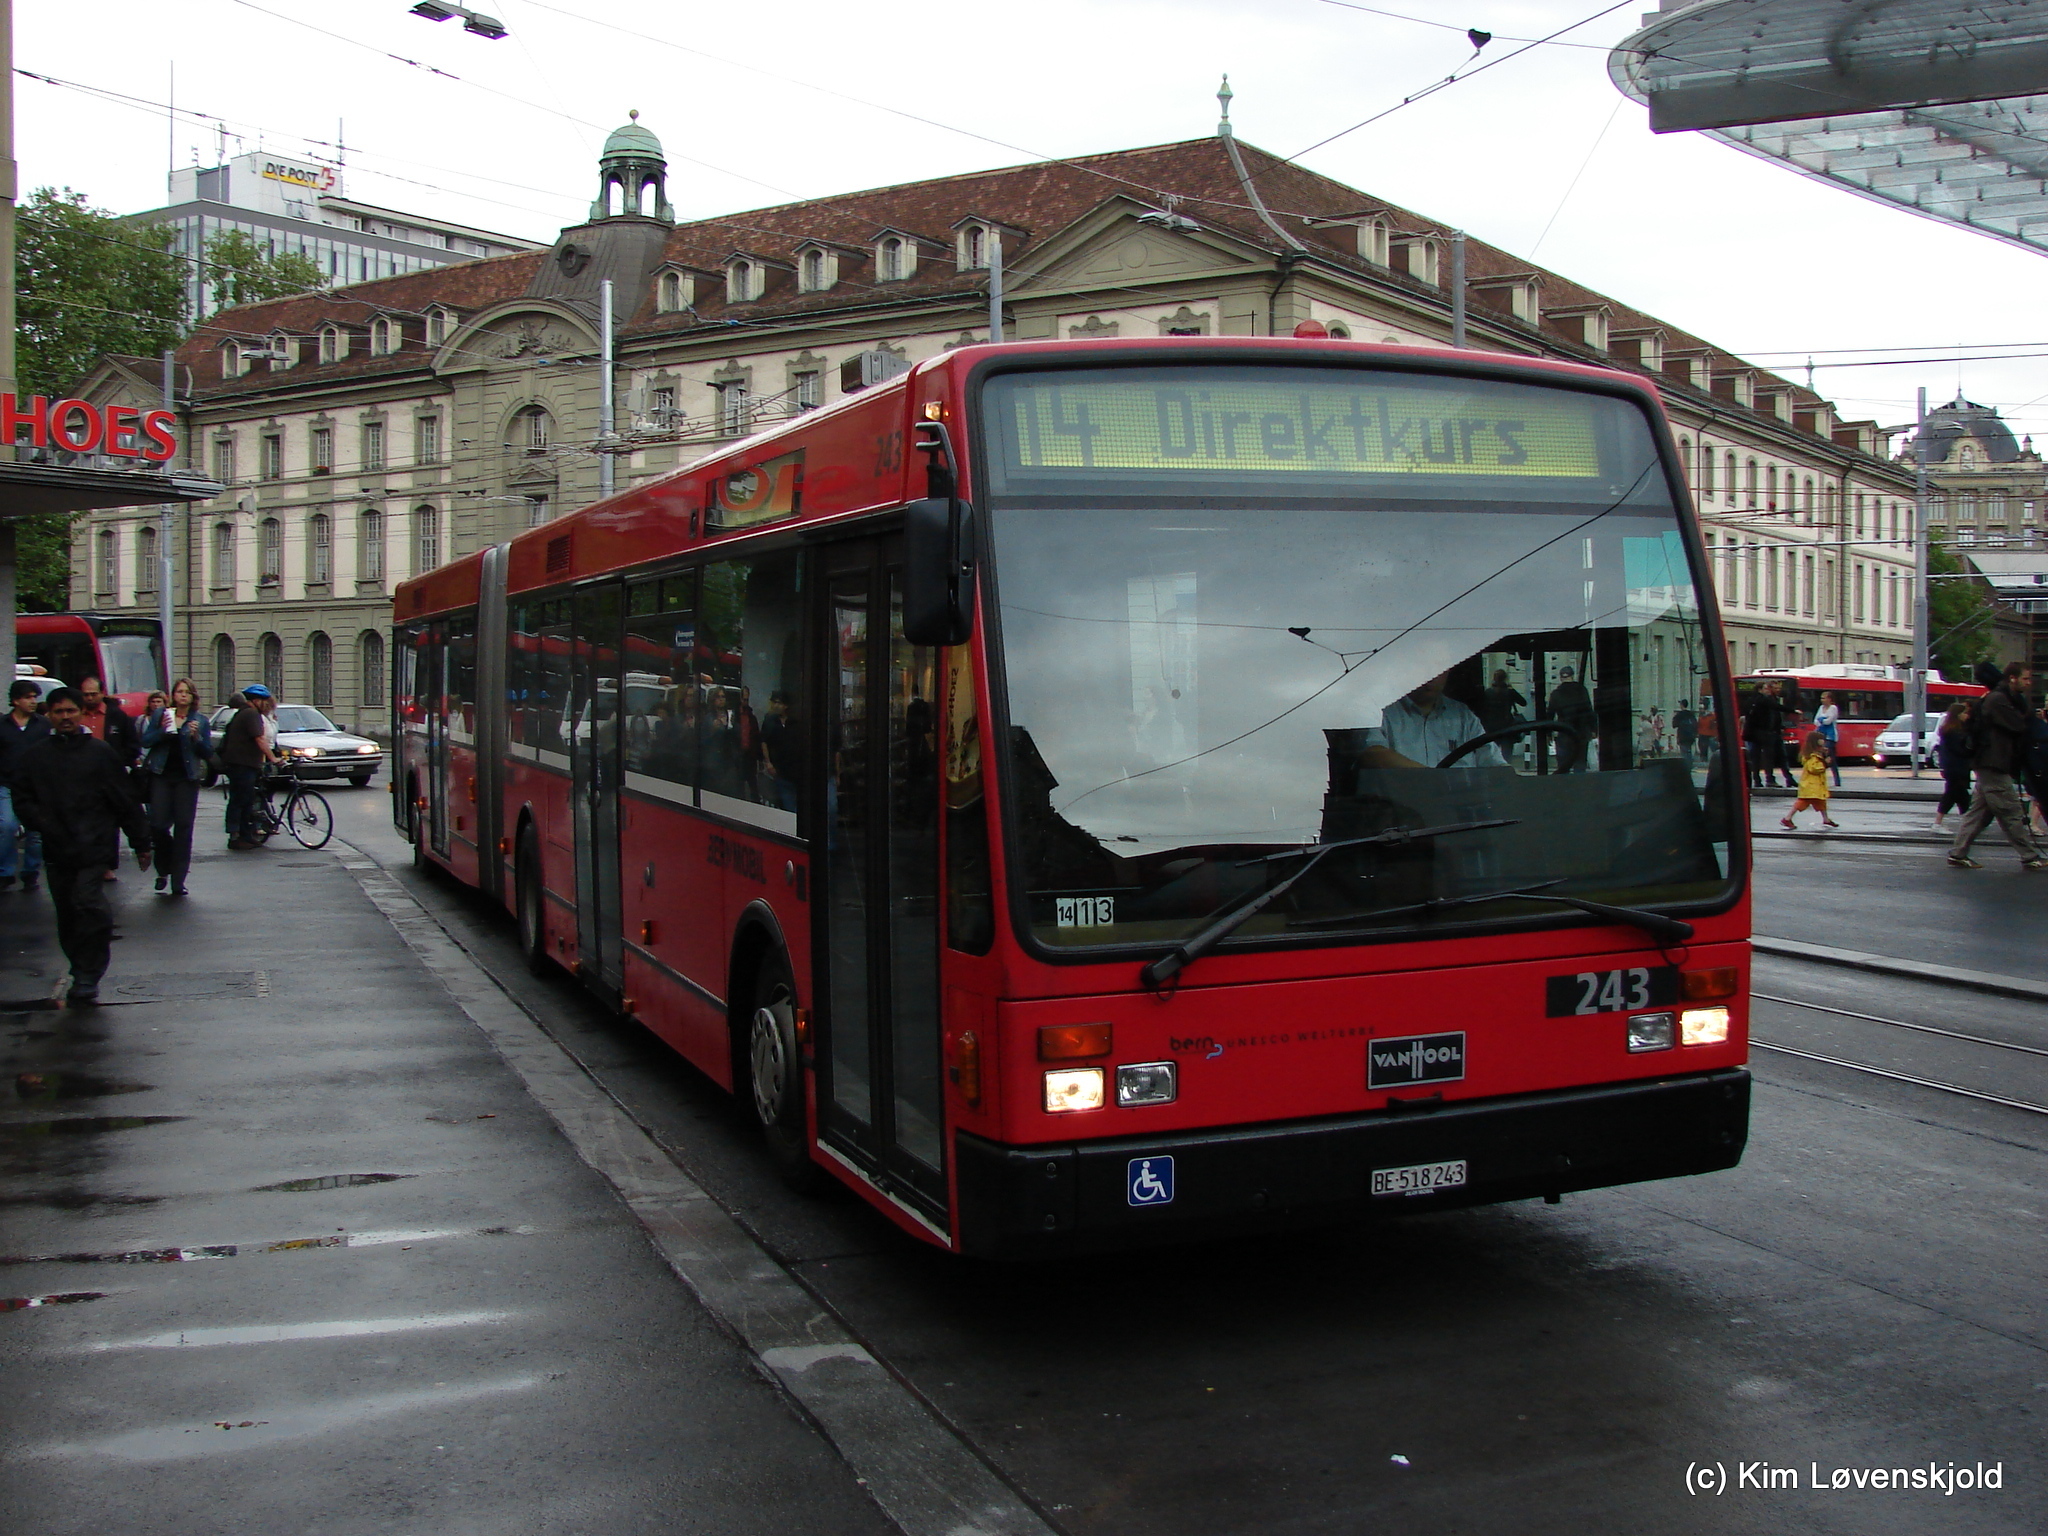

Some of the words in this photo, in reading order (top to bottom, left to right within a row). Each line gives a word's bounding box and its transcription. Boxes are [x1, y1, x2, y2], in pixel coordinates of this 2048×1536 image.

[266, 162, 286, 177] DIE
[288, 166, 319, 184] POST
[1, 393, 177, 462] HOES
[1014, 388, 1101, 467] 14
[1155, 389, 1529, 466] Direktkurs
[873, 430, 903, 478] 243
[1575, 967, 1650, 1015] 243
[1170, 1036, 1214, 1052] bern
[1227, 1033, 1290, 1048] UNESCO
[1297, 1026, 1376, 1042] WELTERBE
